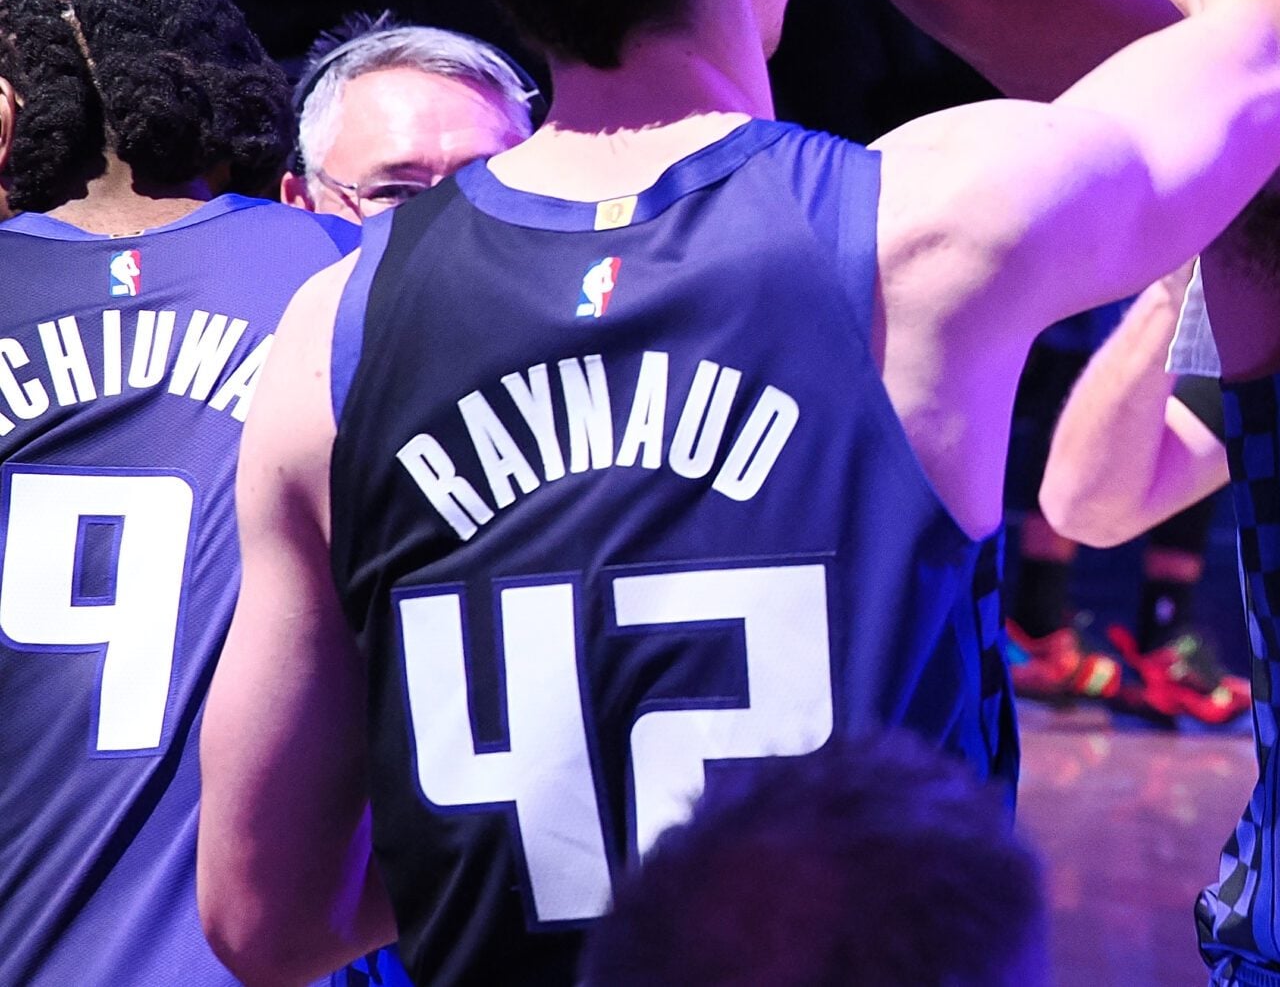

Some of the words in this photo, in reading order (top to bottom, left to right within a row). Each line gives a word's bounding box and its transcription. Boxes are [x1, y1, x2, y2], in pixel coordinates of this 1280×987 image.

[0, 309, 275, 436] CHIUWA
[396, 351, 799, 541] RAYNAUD
[0, 473, 194, 751] 9
[399, 564, 833, 922] 42
